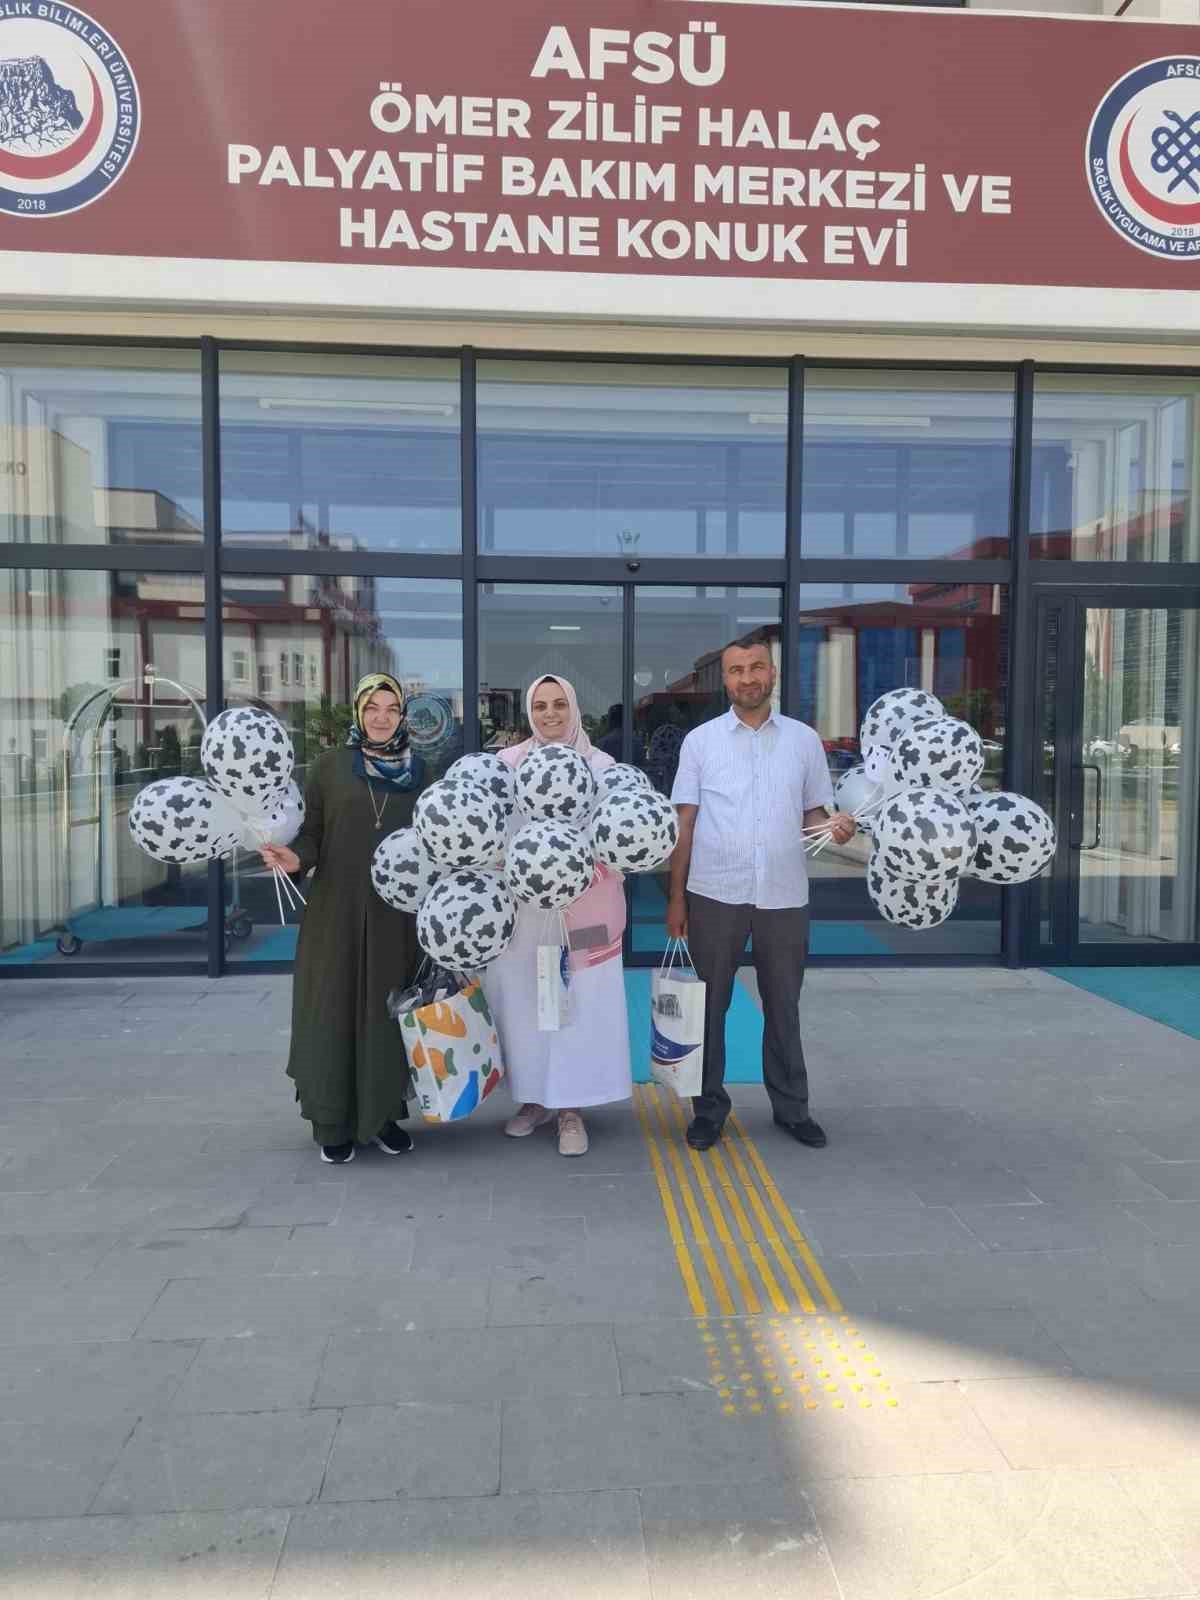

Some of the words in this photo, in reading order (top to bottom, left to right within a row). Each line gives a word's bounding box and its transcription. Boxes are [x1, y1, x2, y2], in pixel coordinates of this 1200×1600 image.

[530, 20, 726, 87] AFSÜ
[38, 4, 117, 60] BİLİMLERİ
[99, 61, 133, 180] ÜNİVERSİTESİ
[369, 81, 532, 140] ÖMER
[547, 94, 682, 145] ZİLİF
[698, 107, 881, 161] HALAÇ
[17, 198, 47, 211] 2018
[227, 143, 485, 193] PALYATİF
[501, 156, 676, 204] BAKIM
[694, 163, 926, 211] MERKEZİ
[942, 174, 1012, 214] VE
[1093, 157, 1114, 205] SAĞLIK
[1109, 202, 1167, 251] UYGULAMA
[1169, 239, 1185, 252] VE
[340, 207, 600, 258] HASTANE
[617, 218, 809, 263] KONUK
[823, 218, 908, 266] EVİ
